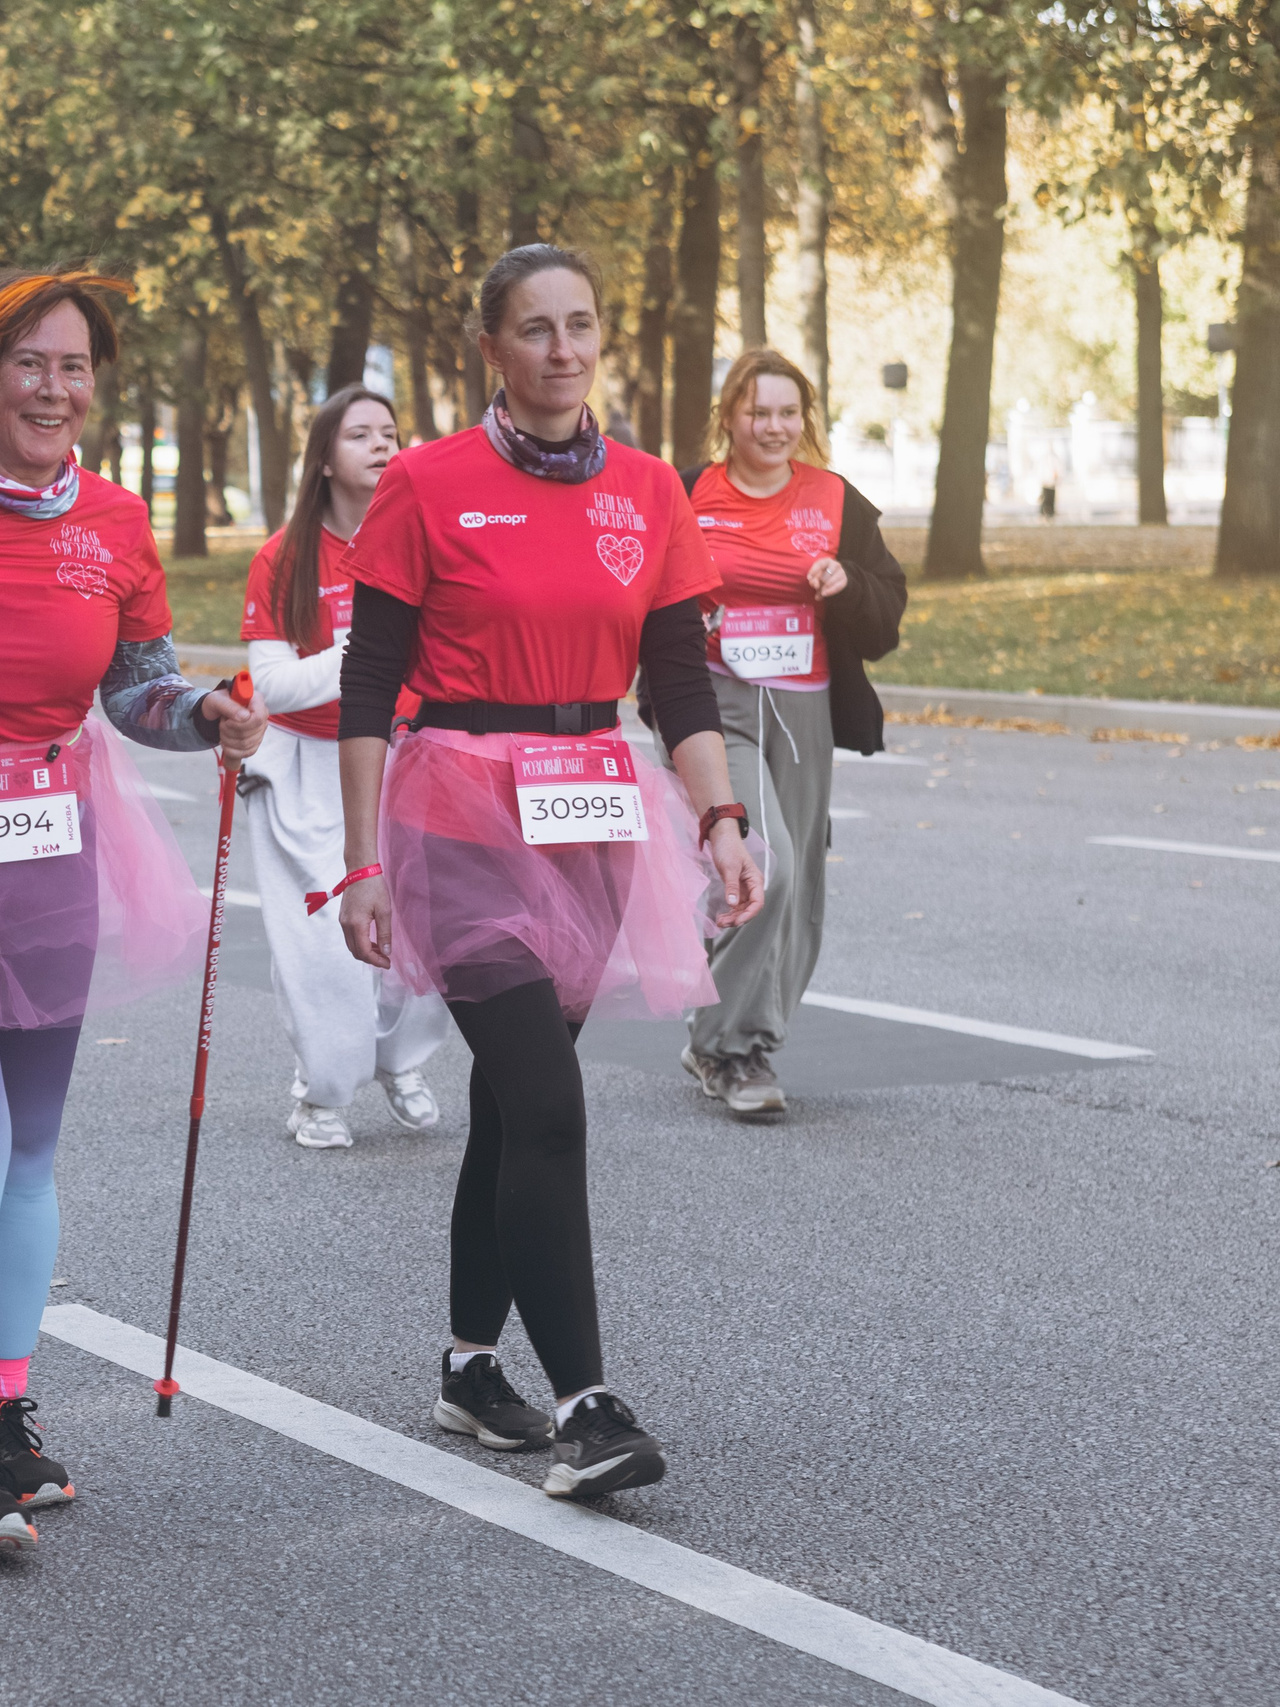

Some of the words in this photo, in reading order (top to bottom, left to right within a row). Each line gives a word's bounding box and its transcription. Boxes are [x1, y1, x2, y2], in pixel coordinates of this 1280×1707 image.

[594, 492, 615, 511] БЕГИ
[616, 495, 635, 513] КАК
[586, 508, 647, 532] ЧУВСТВУЕШЬ
[61, 523, 82, 543] БЕГИ
[82, 527, 101, 547] КАК
[728, 645, 797, 663] 30934
[521, 756, 562, 777] РОЗОВЫЙ
[563, 756, 585, 775] ЗАБЕГ
[529, 796, 625, 821] 30995
[65, 804, 75, 841] МОСКВА
[608, 829, 615, 838] 3
[617, 829, 633, 838] КМ
[32, 845, 39, 856] 3
[41, 843, 60, 855] КМ
